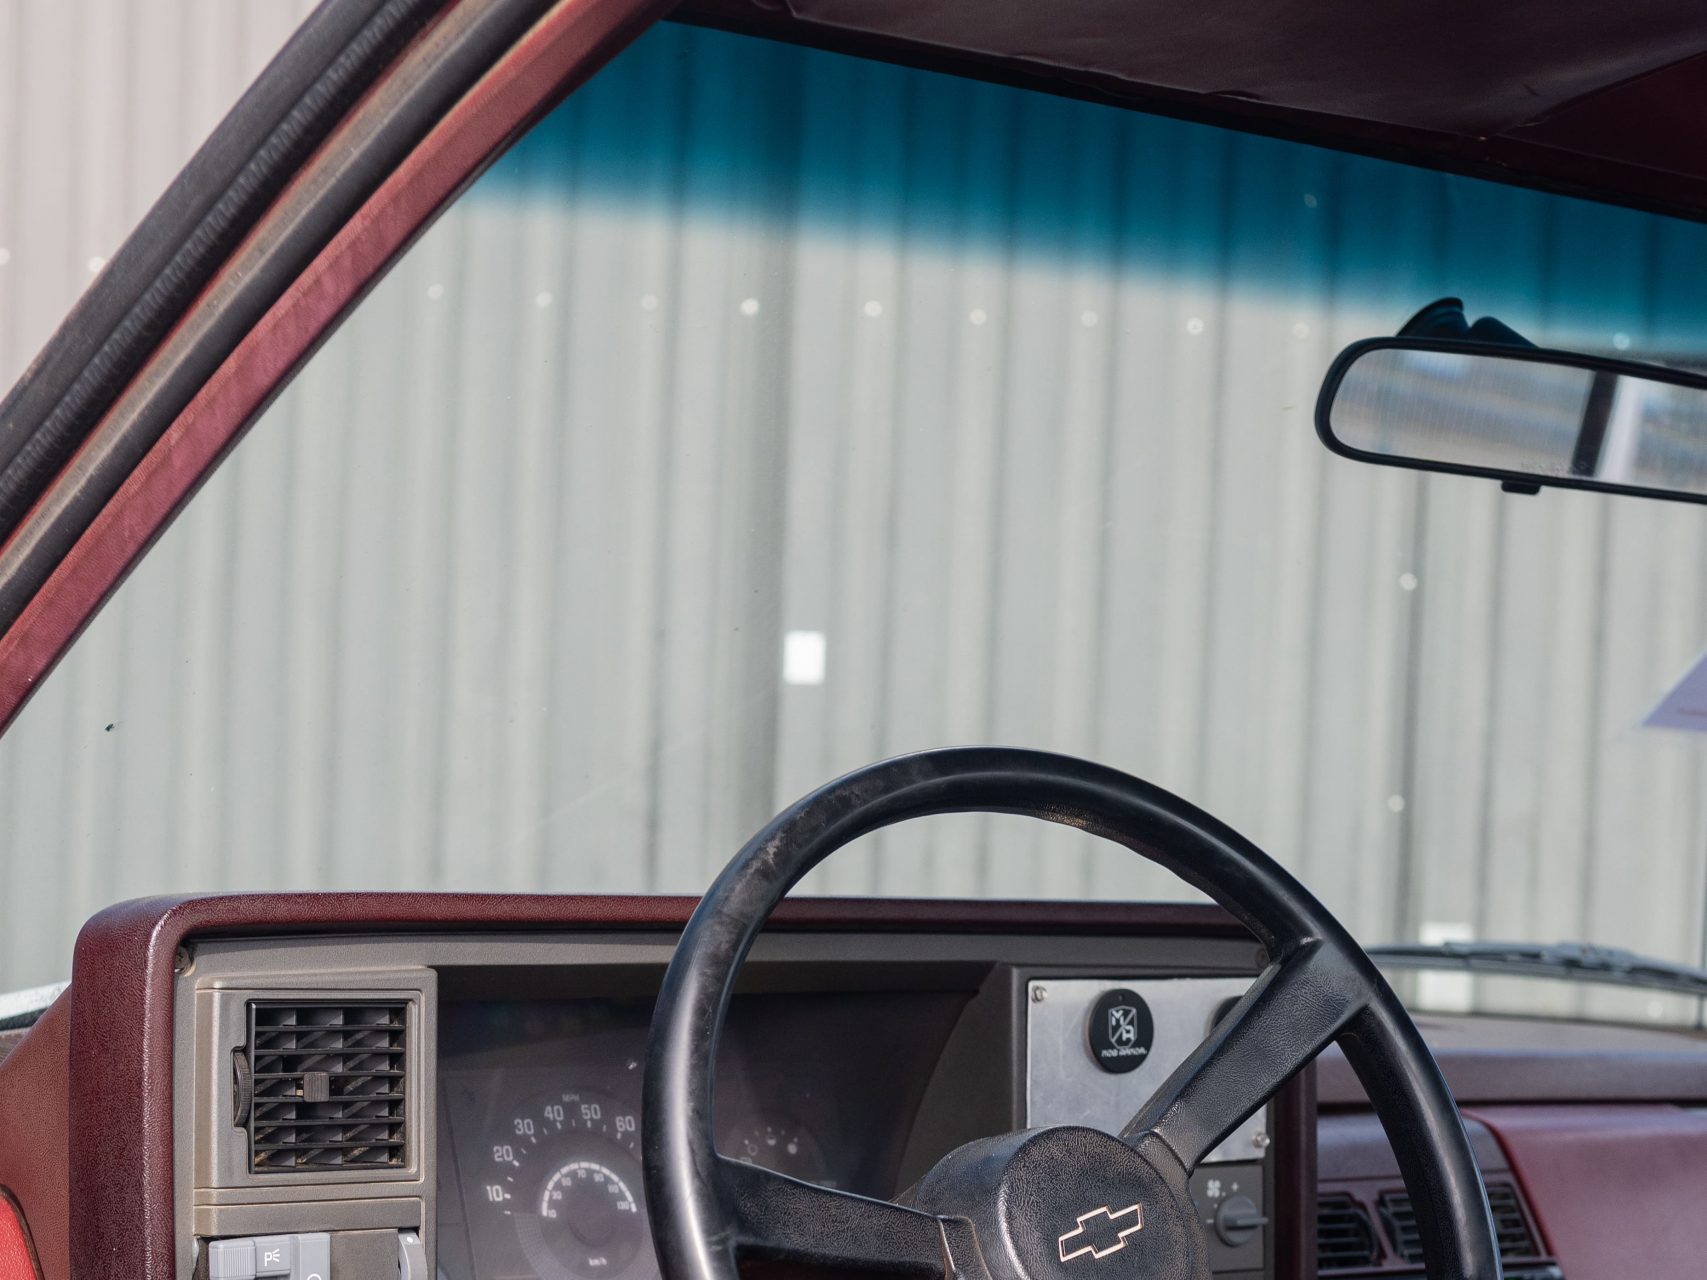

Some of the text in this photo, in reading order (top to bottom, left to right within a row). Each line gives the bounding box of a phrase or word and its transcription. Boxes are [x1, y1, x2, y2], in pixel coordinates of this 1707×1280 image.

[562, 1094, 580, 1102] MPH
[544, 1105, 564, 1121] 40
[581, 1104, 601, 1120] 50
[514, 1118, 534, 1135] 30
[616, 1116, 635, 1132] 60
[493, 1145, 513, 1162] 20
[486, 1185, 504, 1202] 10
